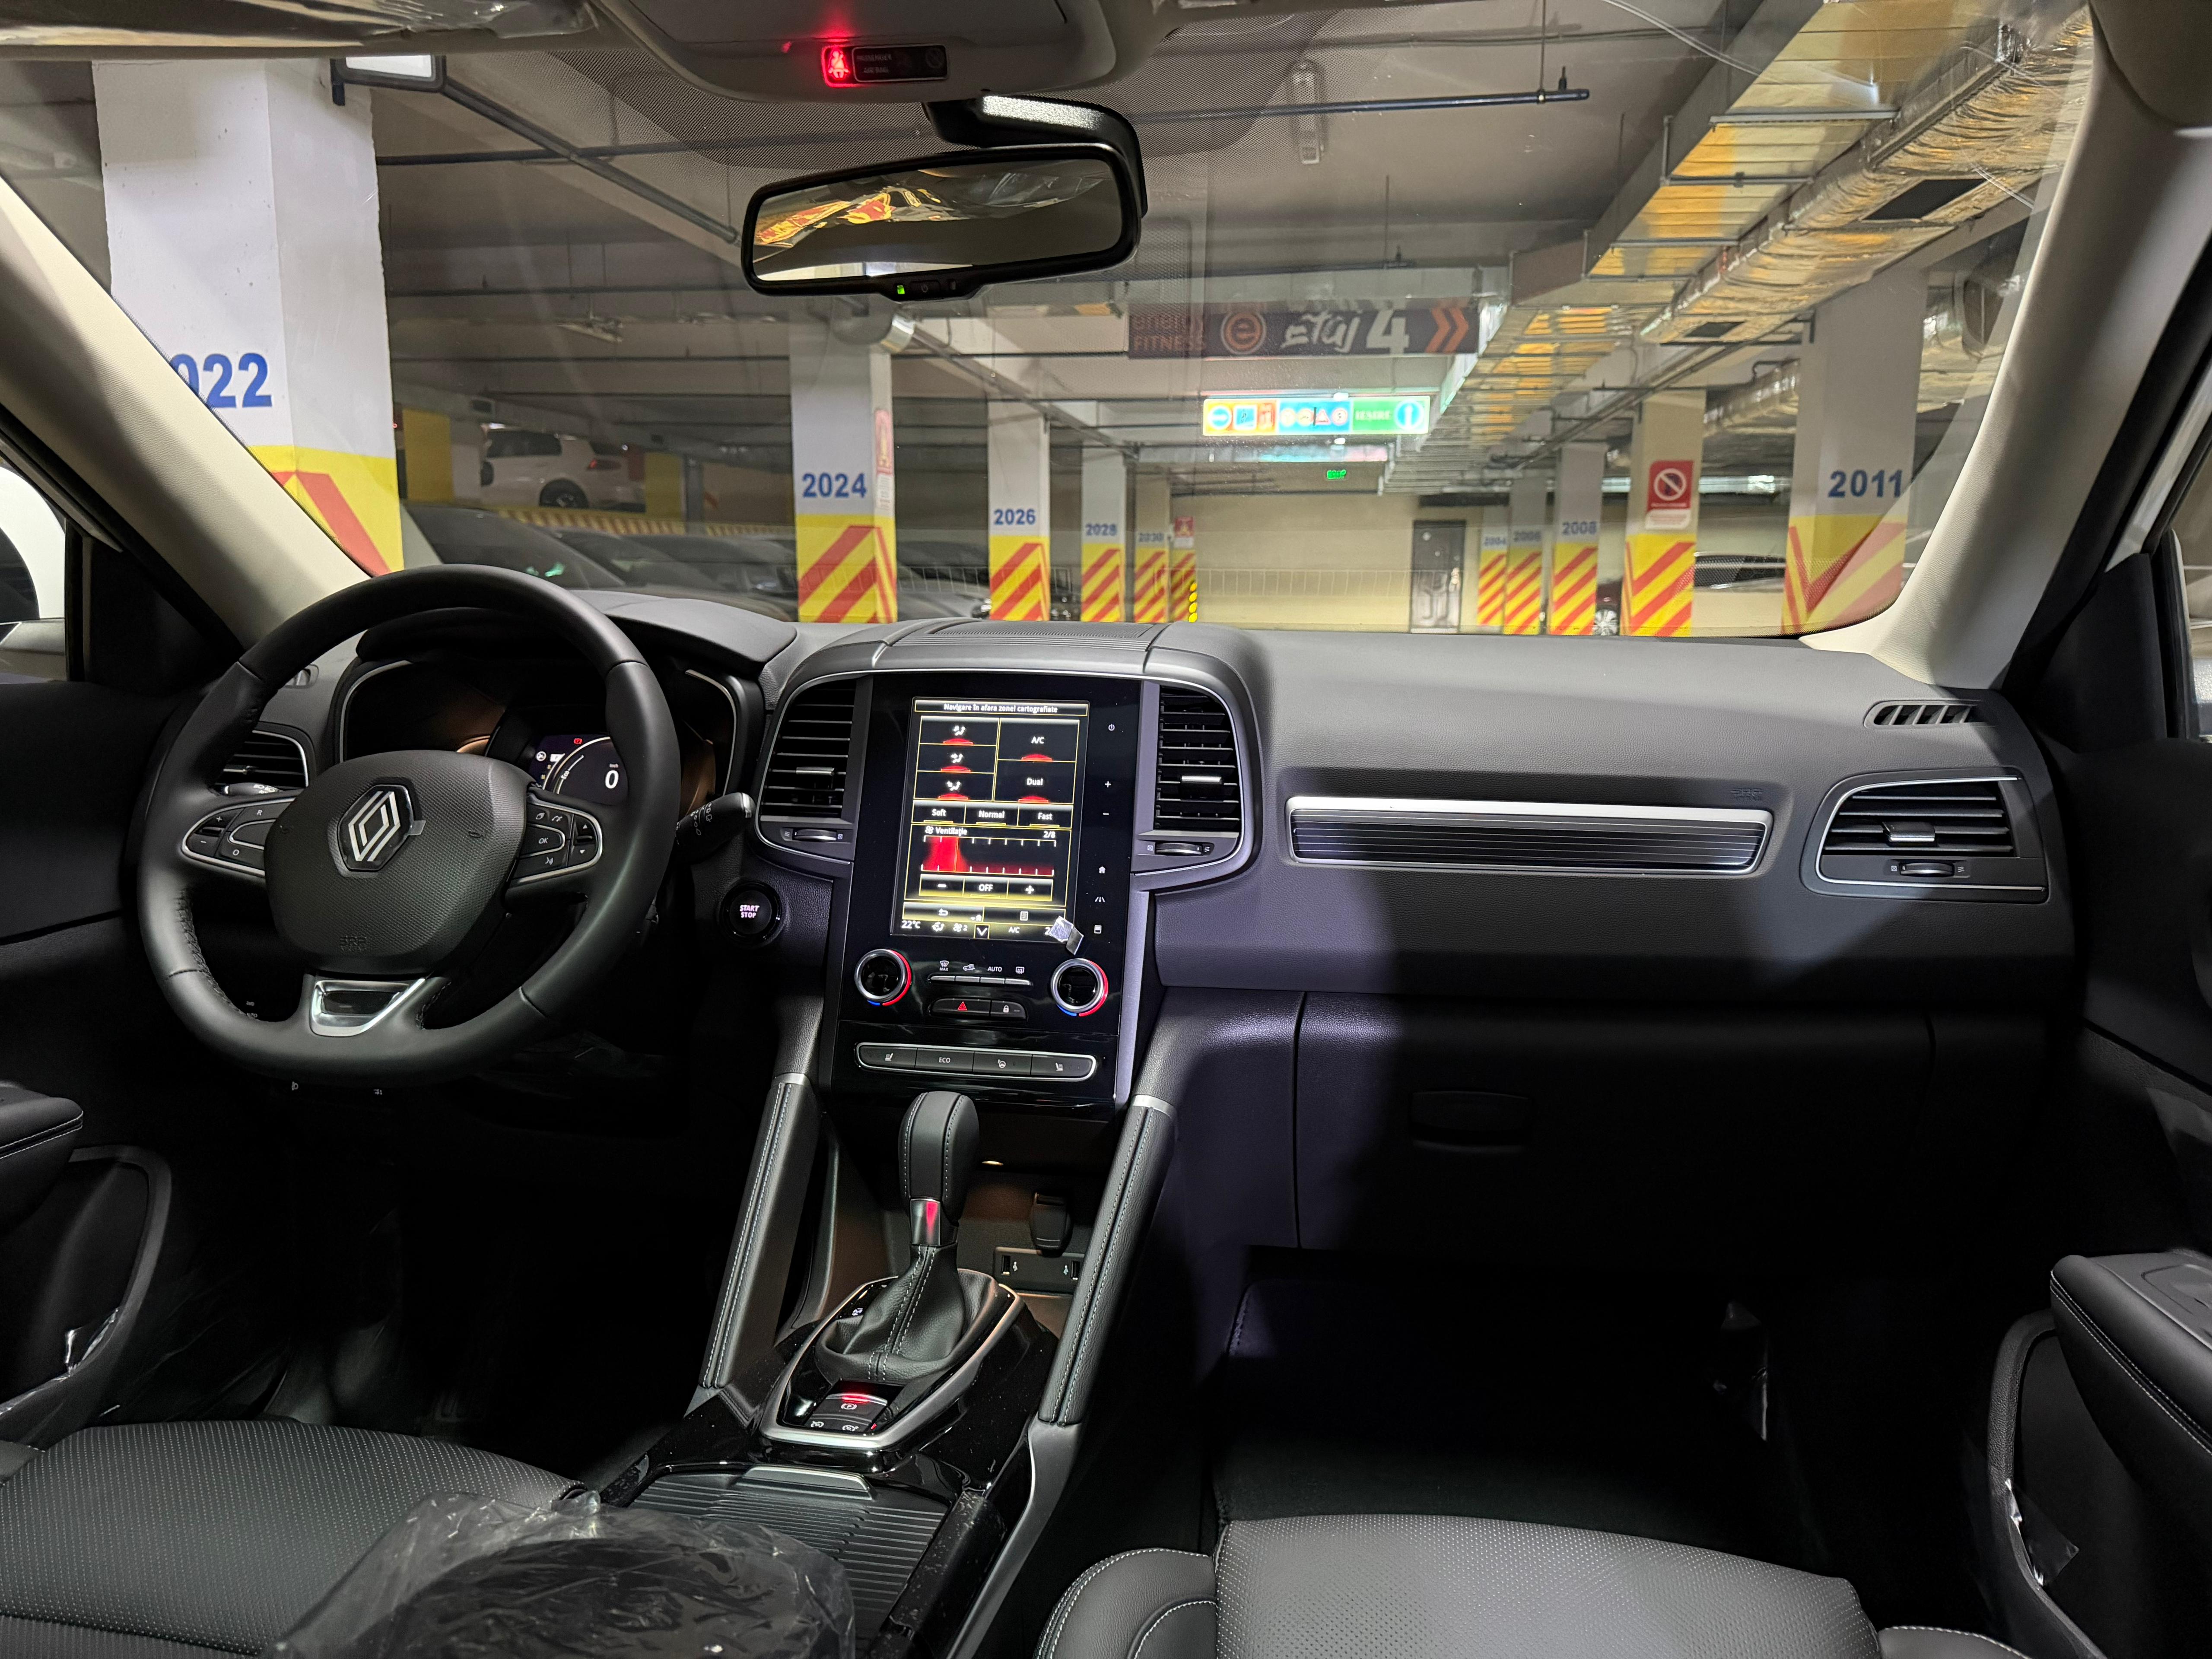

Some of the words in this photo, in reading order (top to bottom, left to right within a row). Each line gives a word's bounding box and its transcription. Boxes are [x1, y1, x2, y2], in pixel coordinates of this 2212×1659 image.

[169, 353, 272, 408] 022
[802, 473, 866, 498] 2024
[1828, 470, 1903, 498] 2011
[994, 509, 1036, 524] 2026
[944, 703, 972, 712] Navigare
[1017, 706, 1058, 714] cartografiate
[605, 770, 619, 789] 0
[901, 920, 921, 929] 22°C
